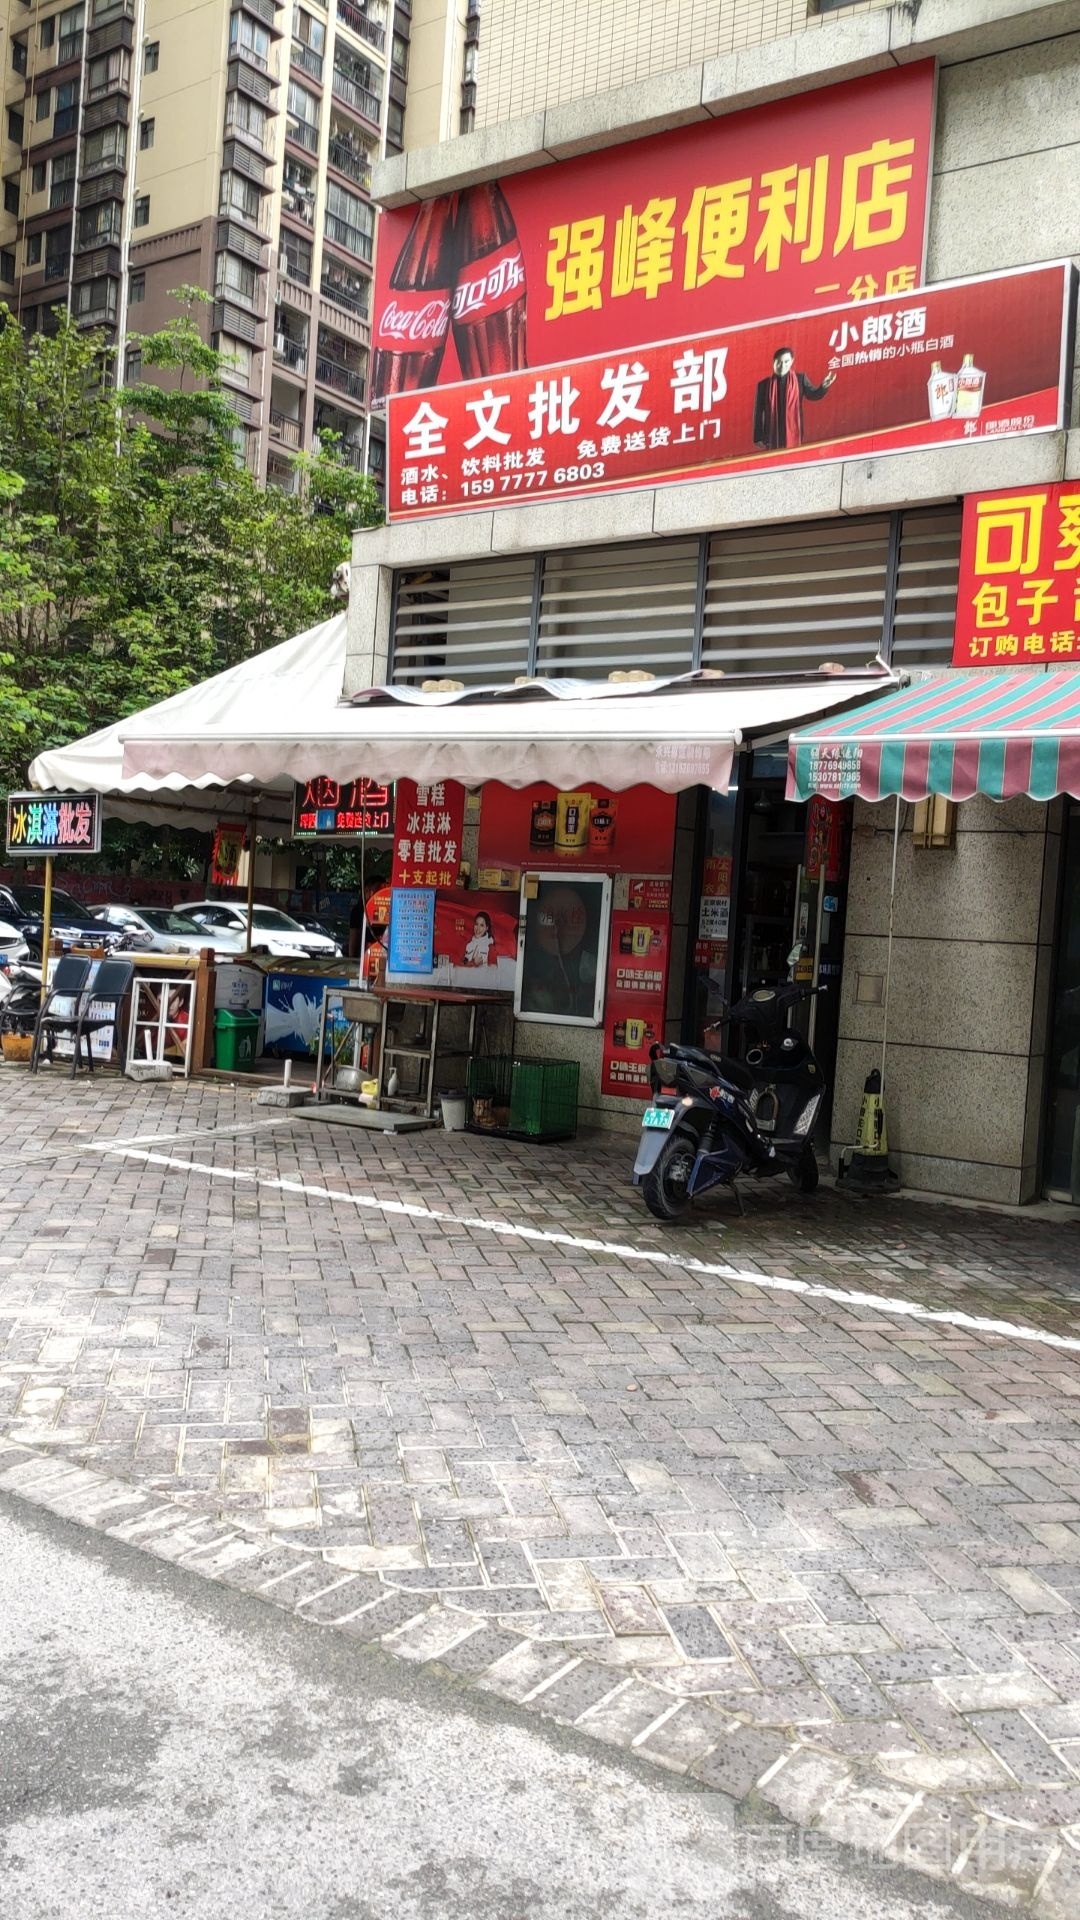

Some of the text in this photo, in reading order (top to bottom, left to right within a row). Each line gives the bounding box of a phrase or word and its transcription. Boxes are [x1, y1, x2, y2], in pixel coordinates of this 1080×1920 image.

[545, 137, 916, 321] 强峰便利店
[828, 306, 927, 353] 小郎酒
[827, 334, 955, 371] 全国热销的小瓶白酒
[401, 346, 730, 460] 全文批发部
[576, 418, 721, 461] 免费送货上门
[461, 479, 495, 498] 159
[499, 471, 548, 492] 7777
[553, 461, 605, 484] 6803
[416, 783, 446, 807] 雪糕
[11, 802, 92, 845] 冰淇淋批发
[406, 811, 452, 835] 冰淇淋
[397, 839, 458, 864] 零售批发
[398, 869, 452, 887] 十支起批
